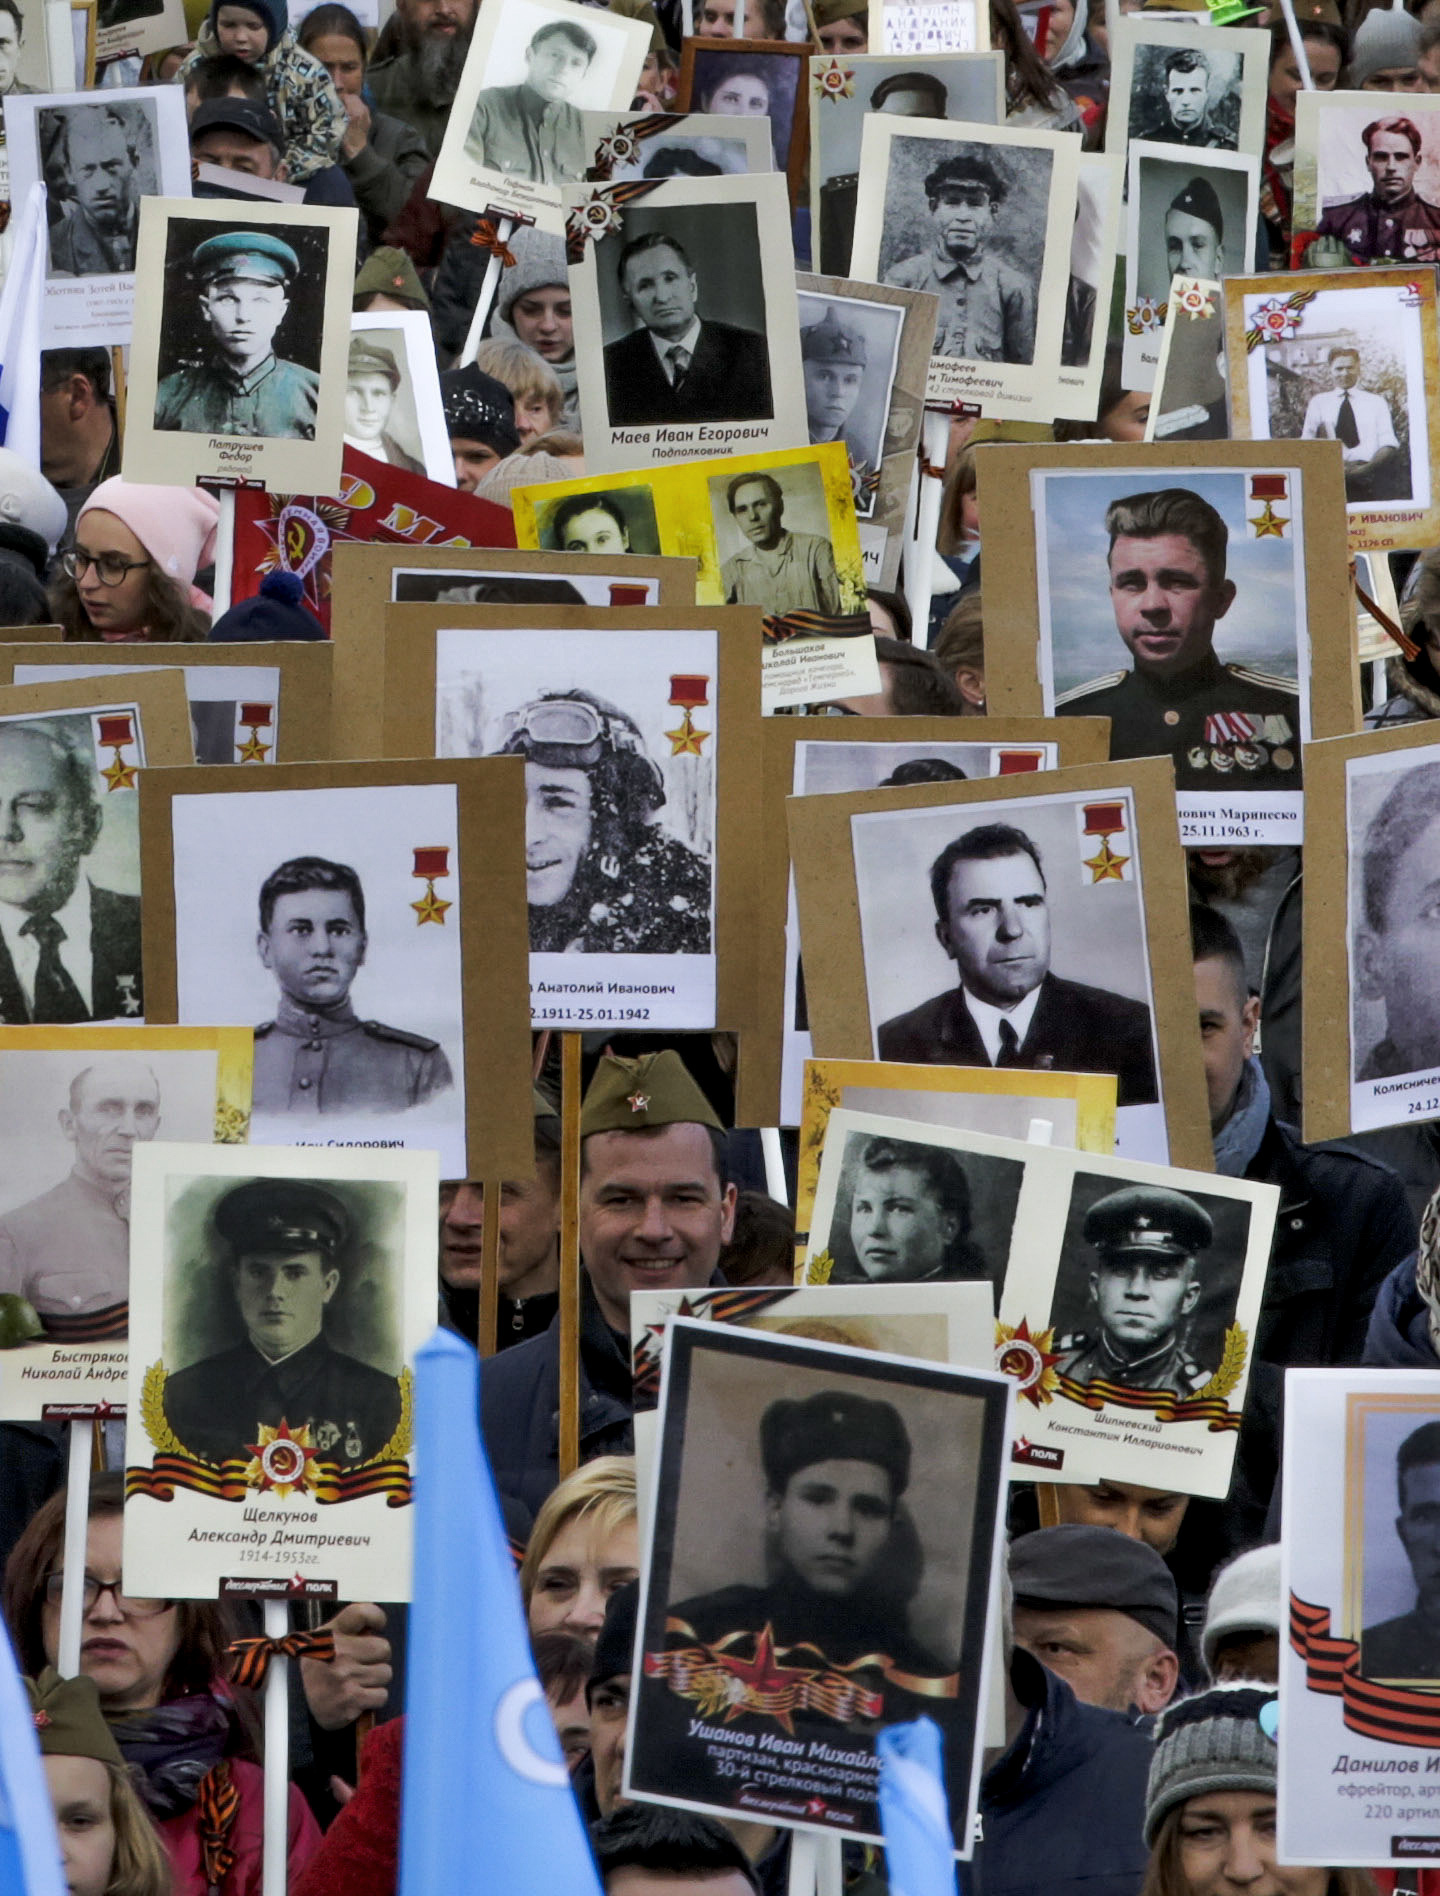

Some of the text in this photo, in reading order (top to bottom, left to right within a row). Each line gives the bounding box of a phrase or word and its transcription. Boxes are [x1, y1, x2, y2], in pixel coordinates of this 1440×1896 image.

[884, 16, 969, 29] АНДРАНИК
[939, 372, 1005, 389] Тимофеевич
[610, 422, 769, 445] Маев Иван Егорович
[208, 439, 264, 454] Патрушев
[651, 444, 733, 460] Подполковник
[219, 450, 252, 465] Федор
[1360, 511, 1424, 525] ИВАНОВИЧ
[771, 641, 826, 660] Большаков
[799, 649, 846, 665] Иванович
[1220, 808, 1298, 823] Маринеско
[1181, 824, 1265, 839] 25.11.1963 г.
[536, 980, 676, 997] Анатолий Иванович
[21, 1366, 82, 1382] Николай
[1046, 1420, 1204, 1458] Константин Илларионович
[1030, 1446, 1058, 1462] ПОЛК
[242, 1508, 318, 1526] Щелкунов
[188, 1527, 371, 1550] Александр Дмитриевич
[238, 1549, 320, 1566] 1914-1953гг.
[225, 1578, 332, 1593] бессмертный ПОЛК
[688, 1719, 756, 1748] Ушанов
[758, 1732, 806, 1756] Иван
[707, 1743, 781, 1772] партизан,
[1332, 1754, 1420, 1777] Данилов
[754, 1768, 842, 1799] стрелковый
[1336, 1781, 1414, 1802] ефрейтор,
[824, 1810, 856, 1825] ПОЛК
[1364, 1805, 1392, 1819] 220
